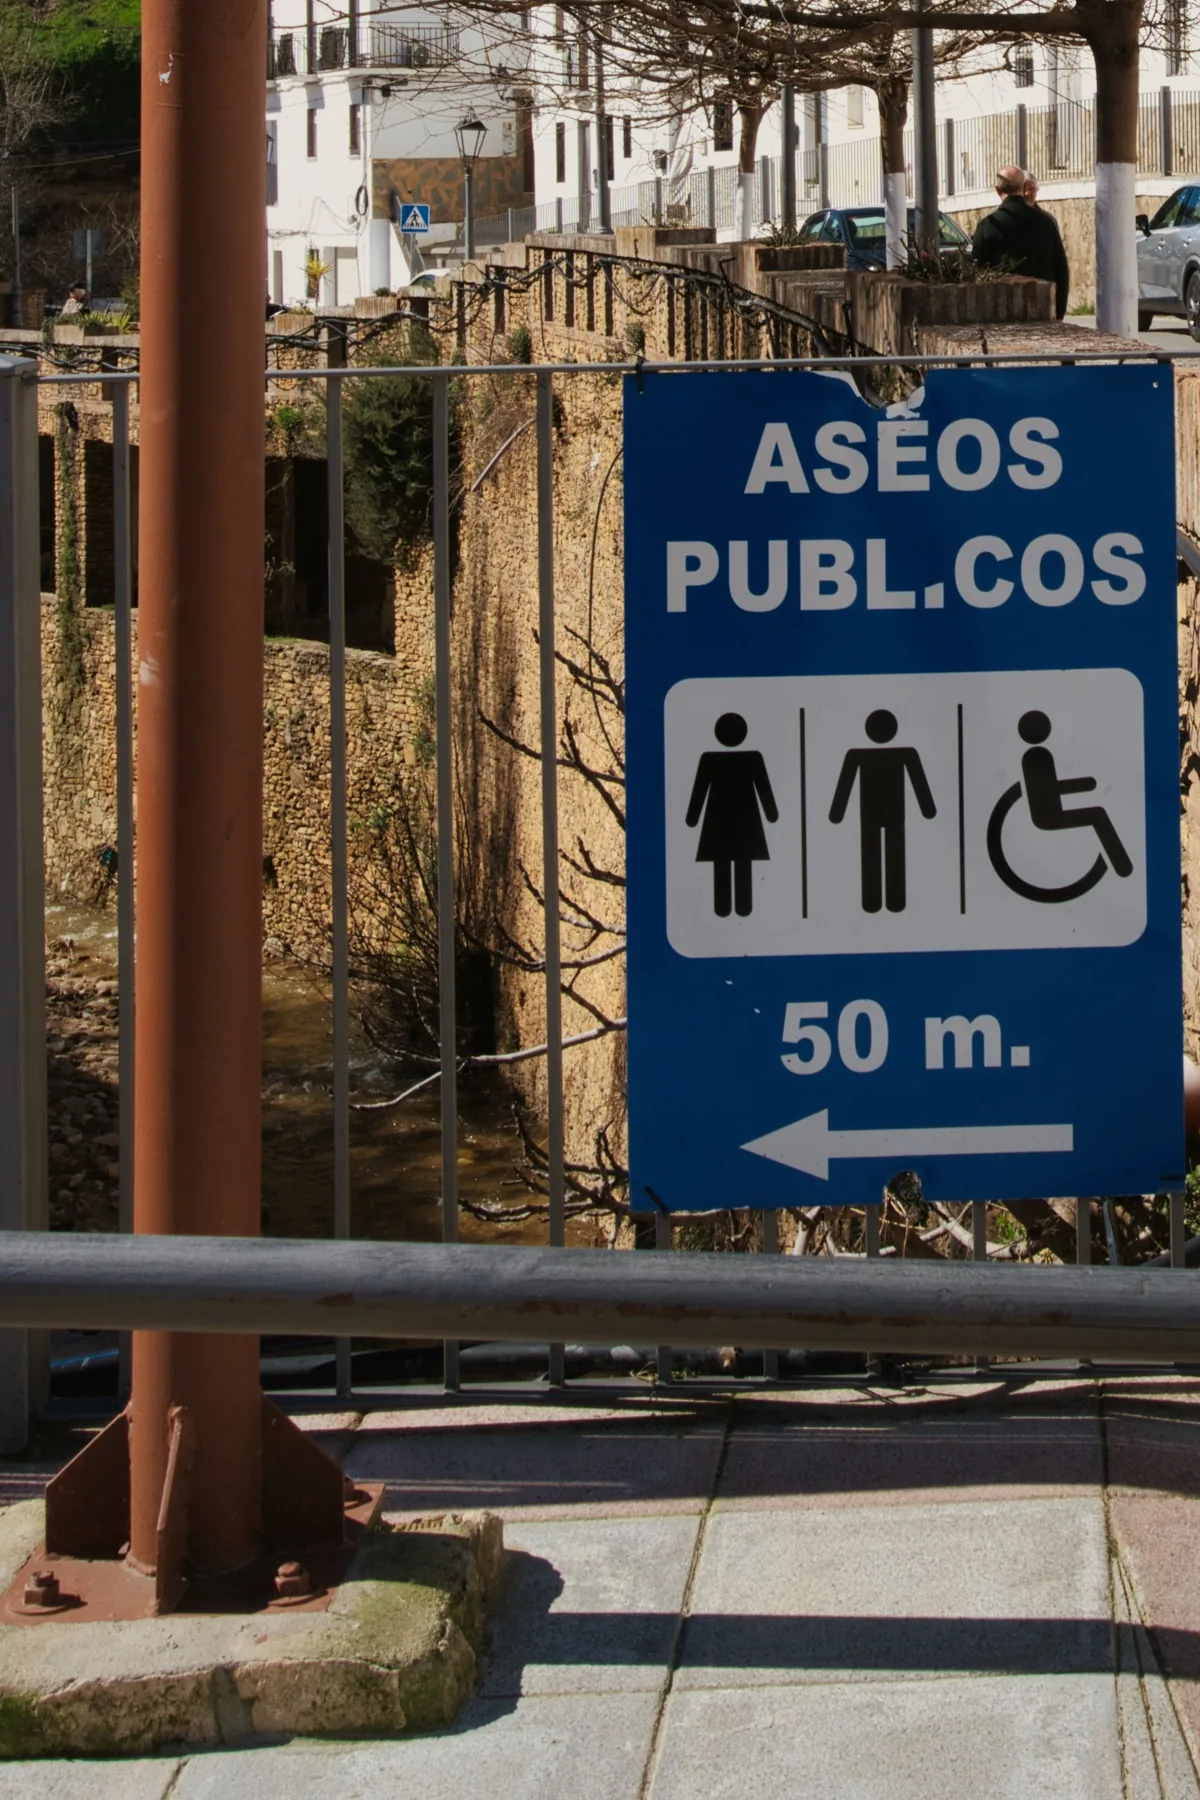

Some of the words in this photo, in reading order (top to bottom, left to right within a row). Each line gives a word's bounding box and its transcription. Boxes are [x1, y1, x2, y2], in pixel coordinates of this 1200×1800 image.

[743, 416, 1063, 494] ASEOS
[780, 999, 888, 1075] 50
[924, 1013, 1030, 1071] m.
